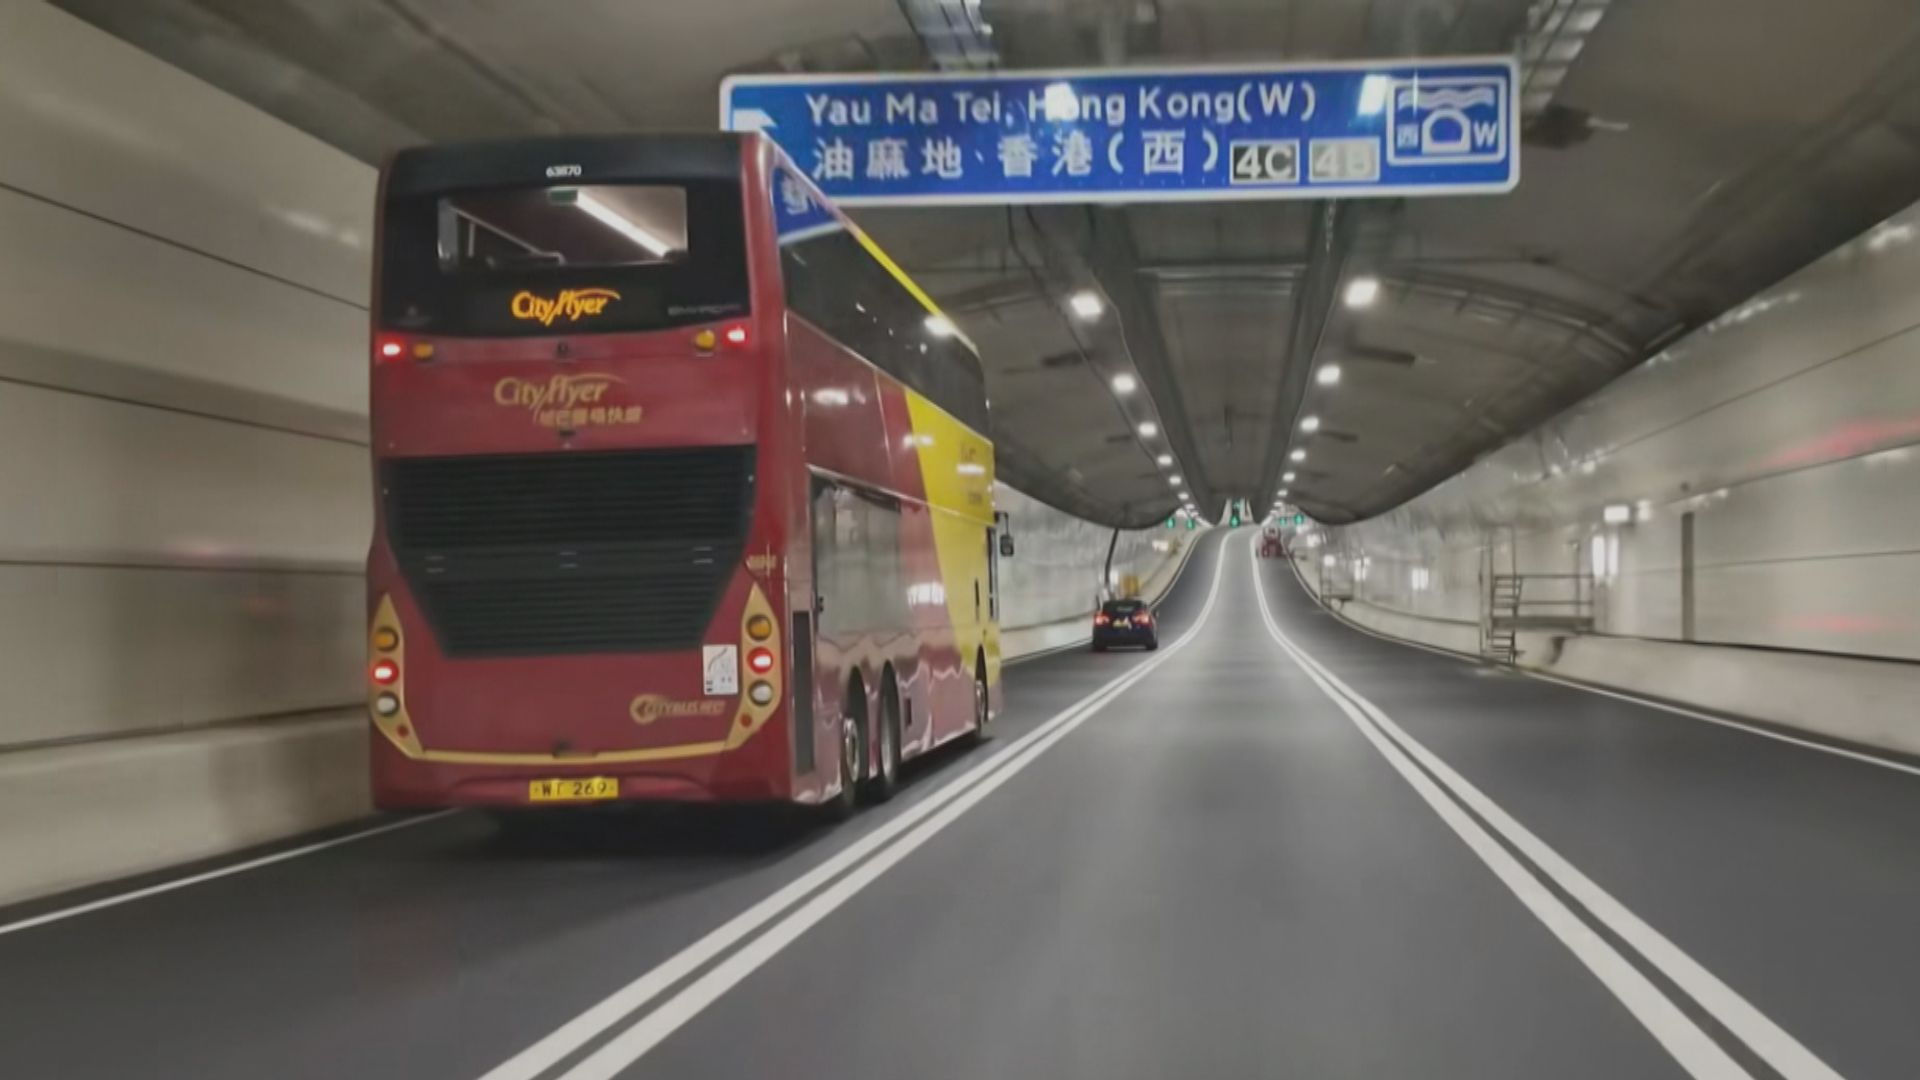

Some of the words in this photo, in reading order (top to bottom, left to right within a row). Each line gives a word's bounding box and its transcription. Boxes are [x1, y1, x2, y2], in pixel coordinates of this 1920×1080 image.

[806, 91, 871, 126] Yau
[886, 91, 939, 125] Ma
[1027, 88, 1126, 127] Hng
[1138, 81, 1316, 127] Kong(W)
[1473, 121, 1498, 148] W
[1236, 145, 1293, 179] 4C
[1315, 144, 1371, 178] 4B
[573, 781, 607, 796] 269
